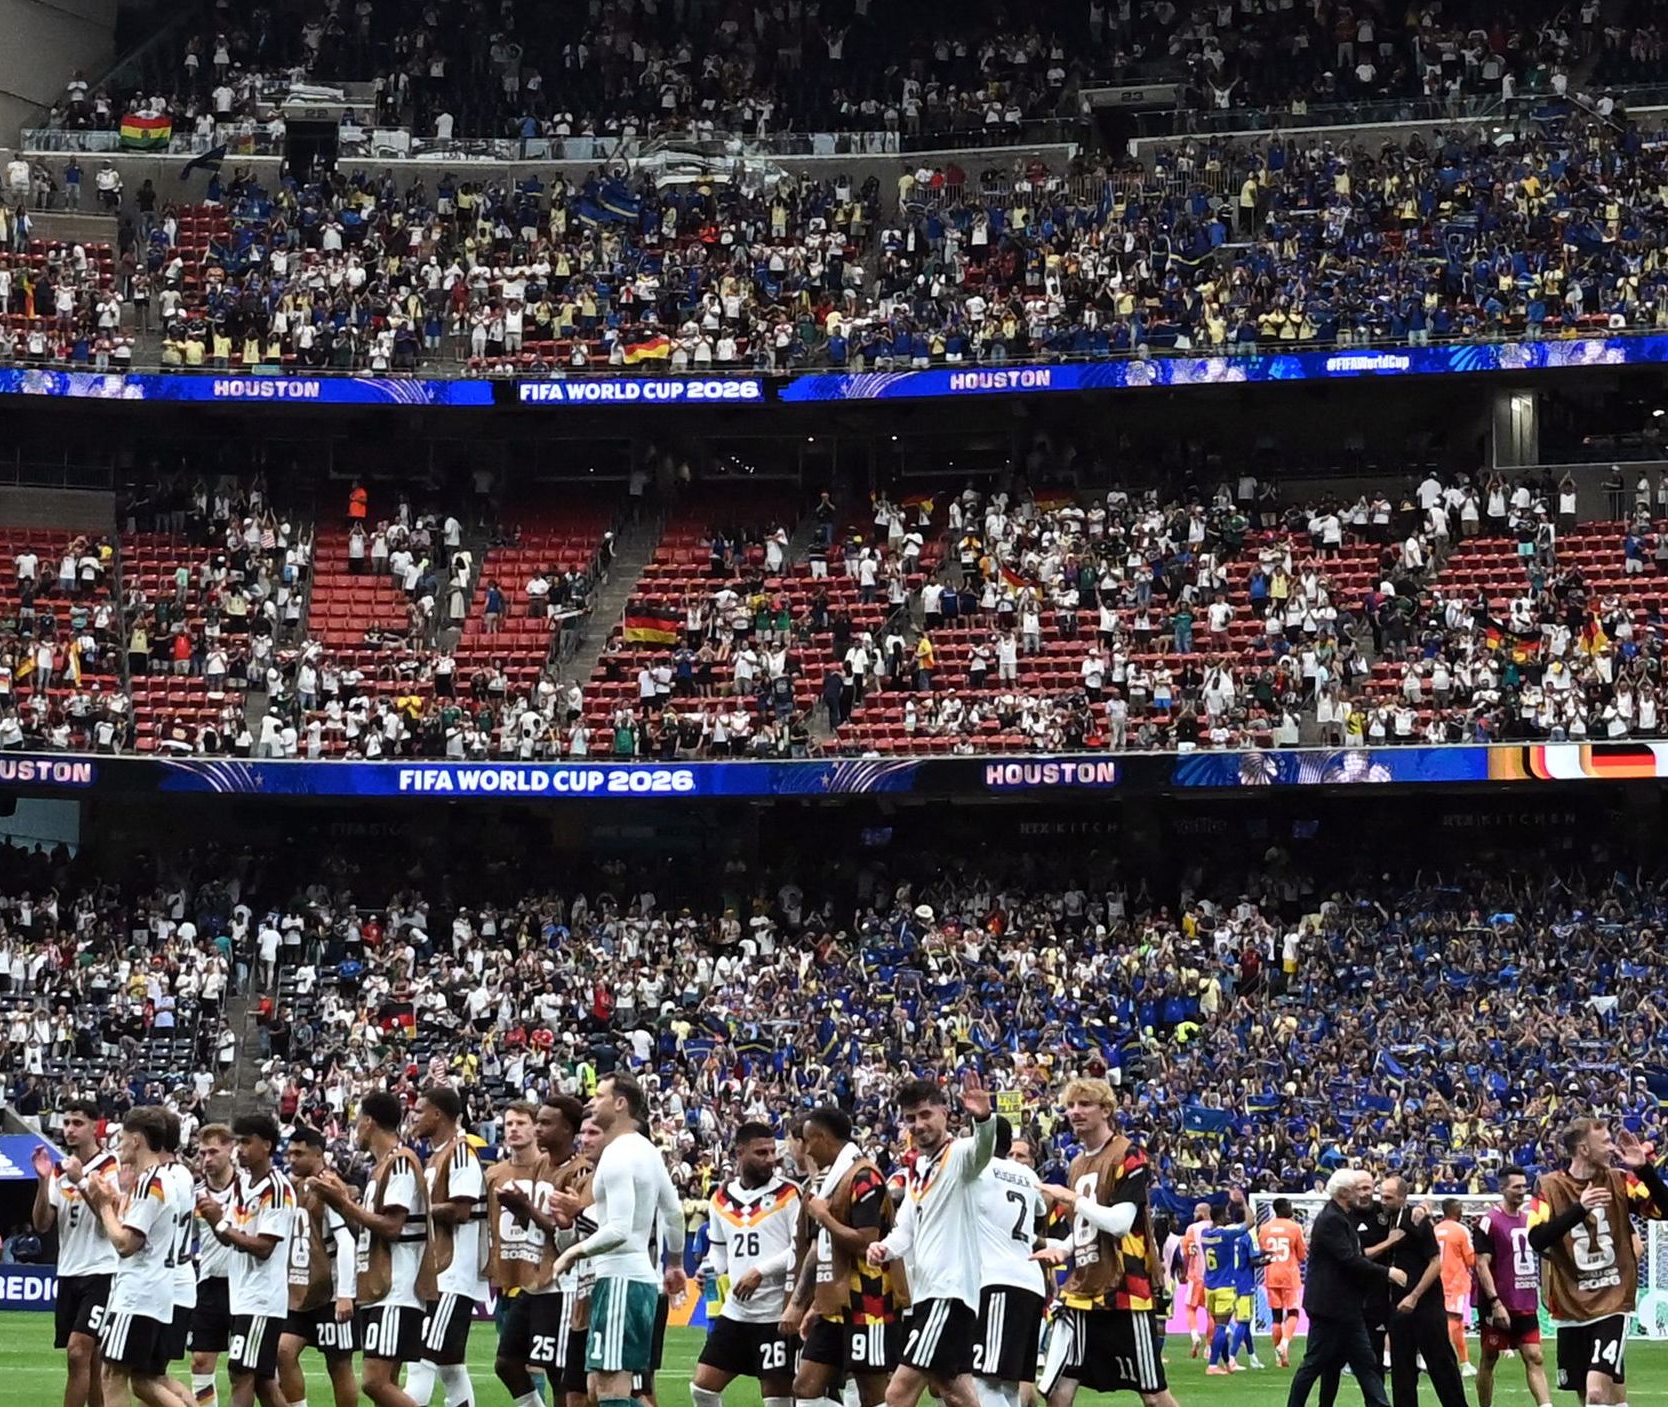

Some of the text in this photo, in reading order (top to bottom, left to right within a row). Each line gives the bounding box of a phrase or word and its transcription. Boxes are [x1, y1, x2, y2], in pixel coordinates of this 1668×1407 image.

[1326, 354, 1410, 375] #FIFAWorldCup
[213, 379, 320, 398] HOUSTON
[519, 380, 759, 401] FIFA WORLD CUP 2026
[949, 368, 1051, 391] HOUSTON
[399, 769, 694, 792] FIFA WORLD CUP 2026
[986, 761, 1116, 786] HOUSTON
[1481, 812, 1576, 826] KITCHEN
[69, 1205, 79, 1228] 5
[1006, 1190, 1030, 1243] 2
[734, 1231, 760, 1258] 26
[88, 1305, 102, 1330] 5
[316, 1322, 335, 1346] 20
[590, 1331, 603, 1360] 1
[530, 1335, 556, 1361] 25
[759, 1341, 786, 1370] 26
[851, 1333, 866, 1361] 9
[972, 1343, 983, 1370] 2
[1591, 1339, 1619, 1365] 14
